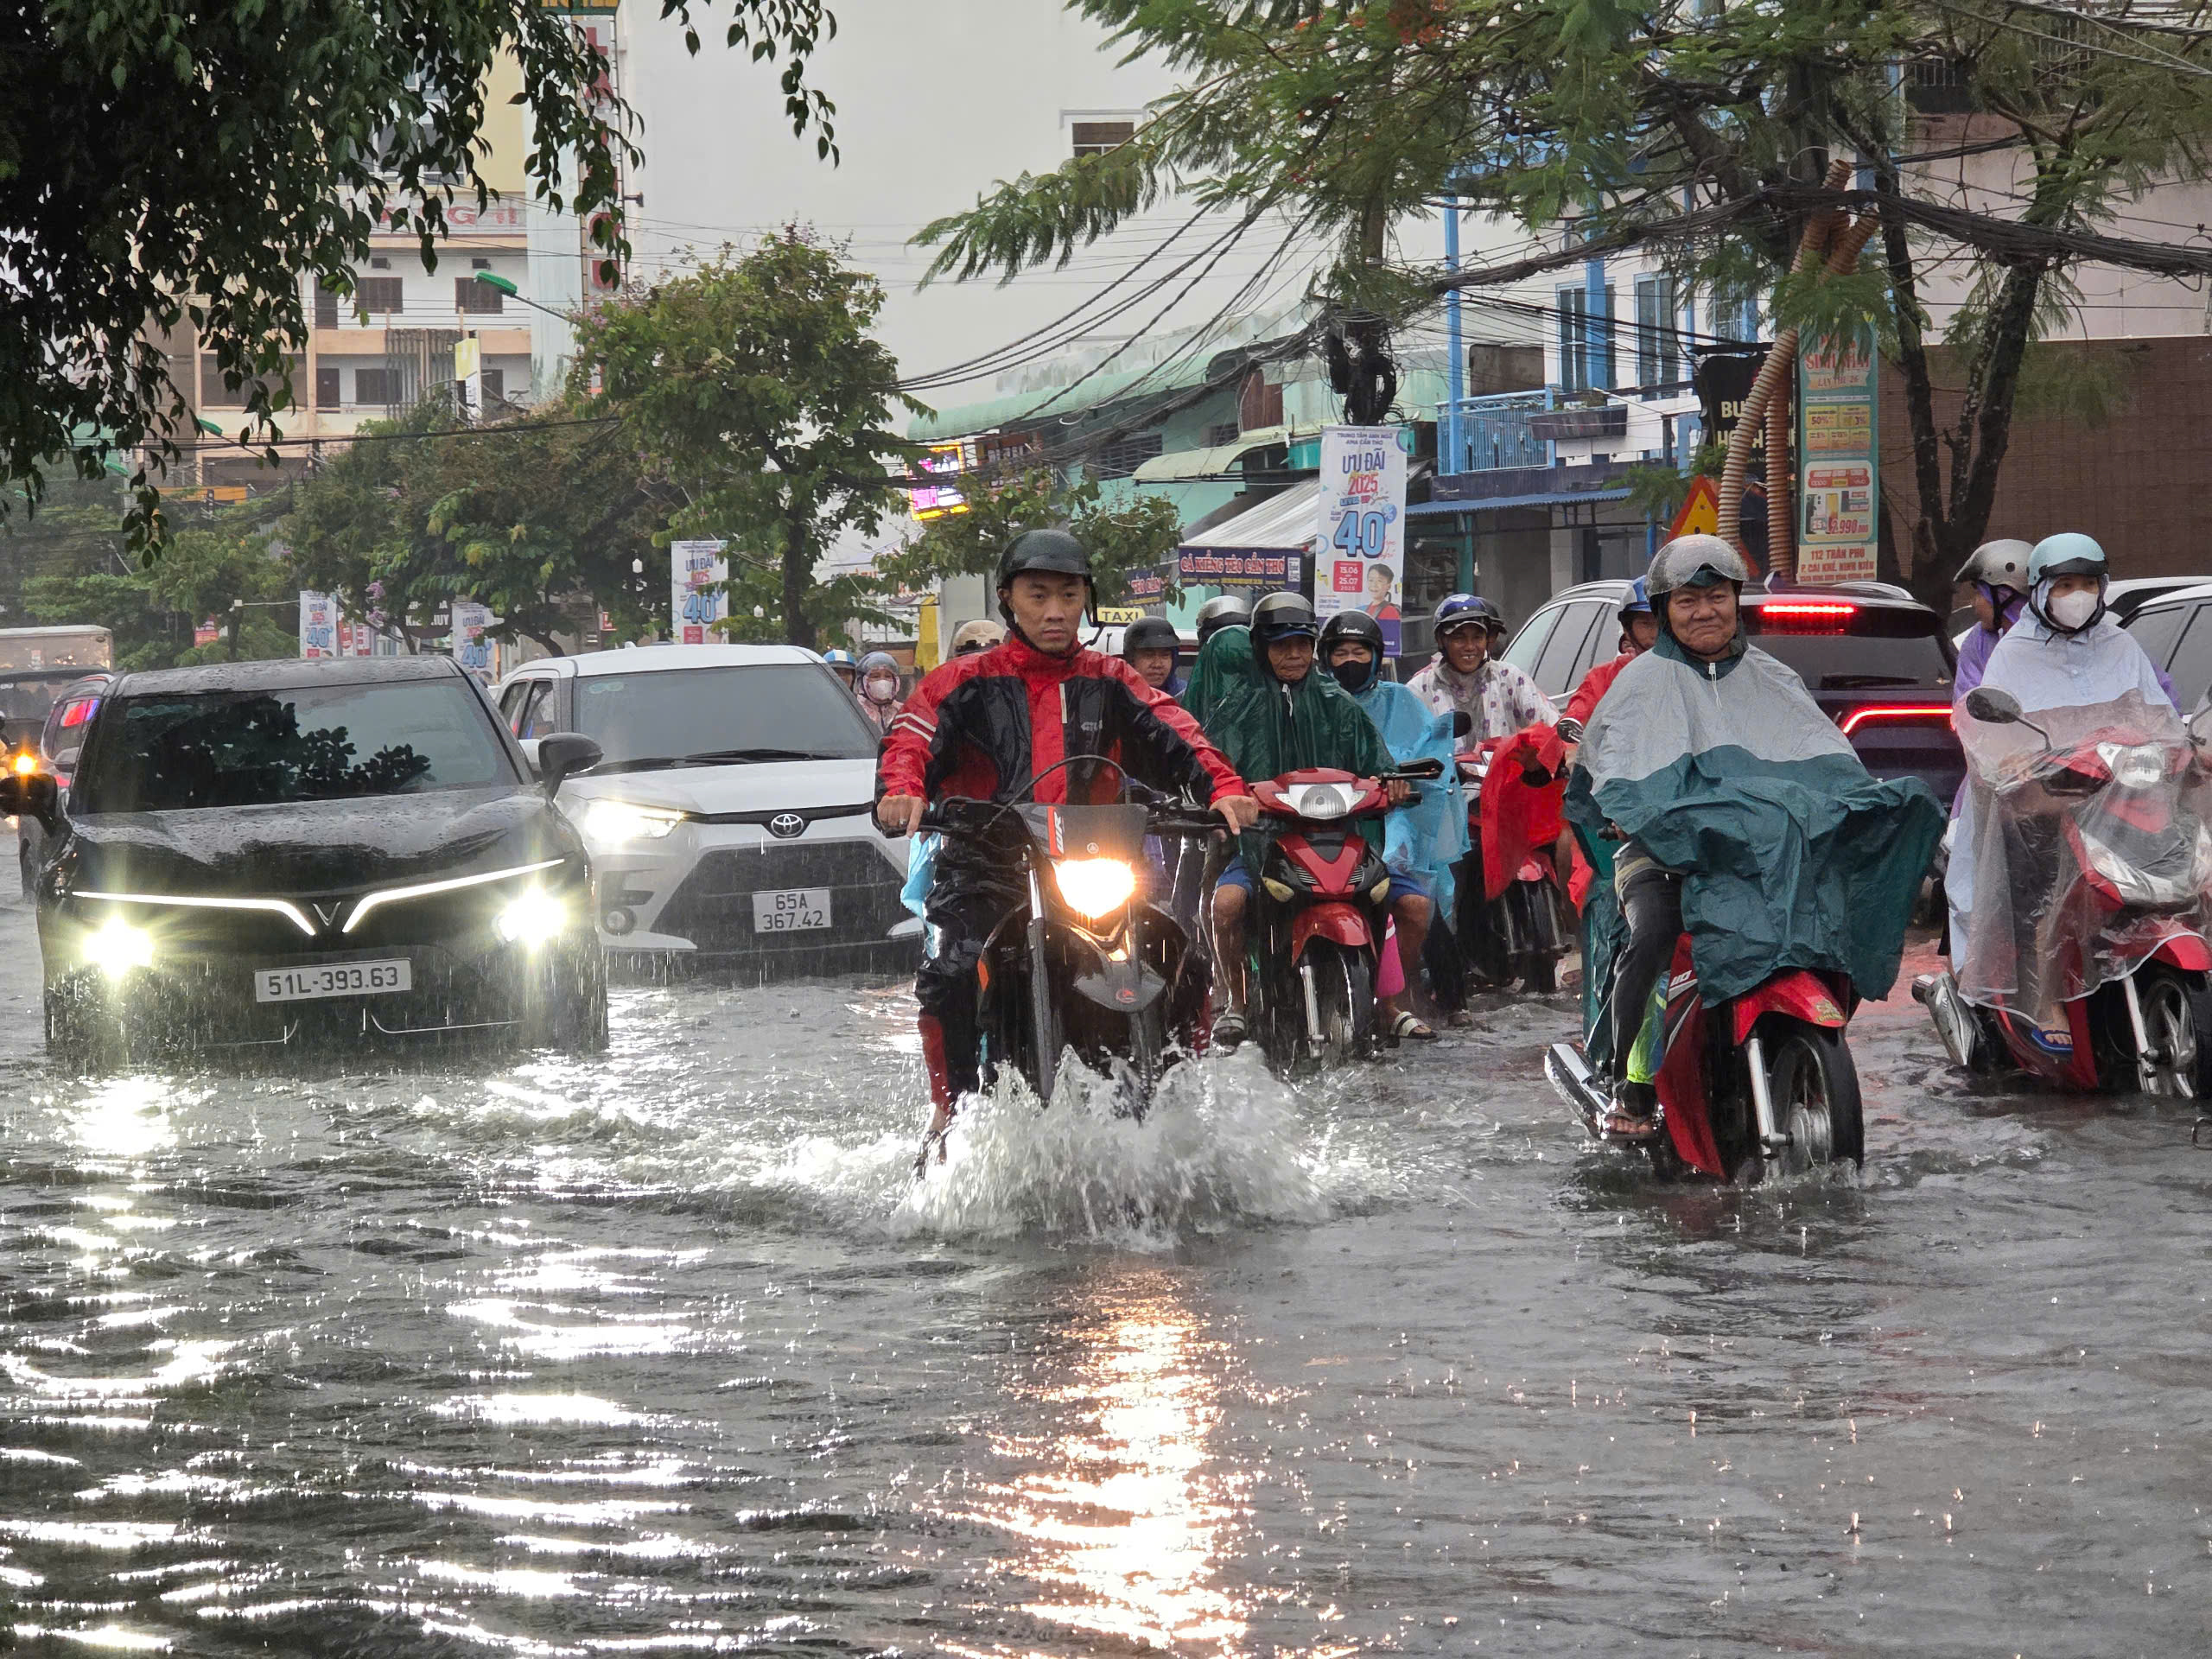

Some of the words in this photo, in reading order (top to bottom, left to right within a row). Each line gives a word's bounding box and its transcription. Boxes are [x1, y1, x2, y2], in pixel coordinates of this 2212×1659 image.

[1348, 474, 1378, 496] 2025
[1333, 510, 1387, 559] 40
[683, 594, 716, 624] 40
[1102, 611, 1139, 621] TAXI
[307, 626, 329, 648] 40
[461, 645, 487, 669] 40
[775, 892, 809, 911] 65A
[762, 910, 823, 931] 367.42
[268, 965, 399, 996] 51L-393.63
